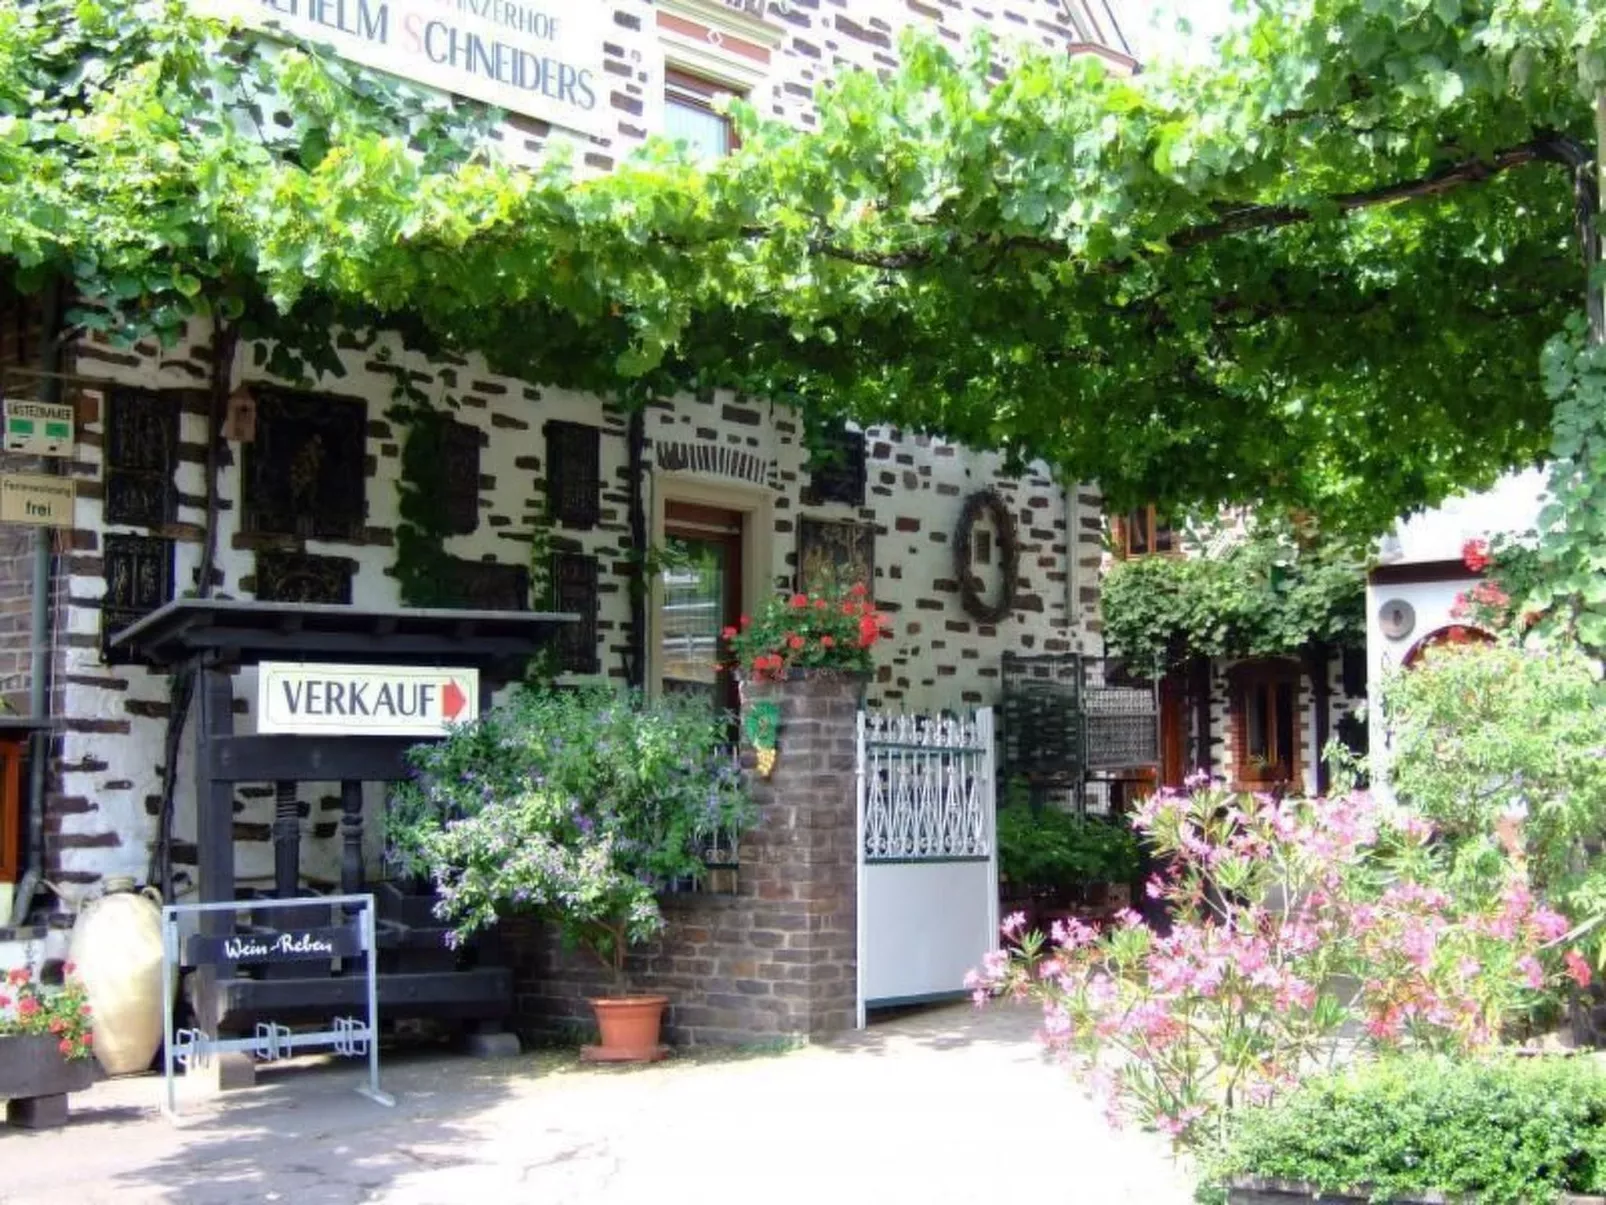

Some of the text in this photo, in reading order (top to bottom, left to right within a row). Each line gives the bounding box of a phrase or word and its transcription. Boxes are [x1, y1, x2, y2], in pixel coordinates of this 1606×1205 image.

[404, 12, 597, 111] SCHNEIDERS
[26, 500, 52, 517] frei
[282, 680, 436, 717] VERKAUF
